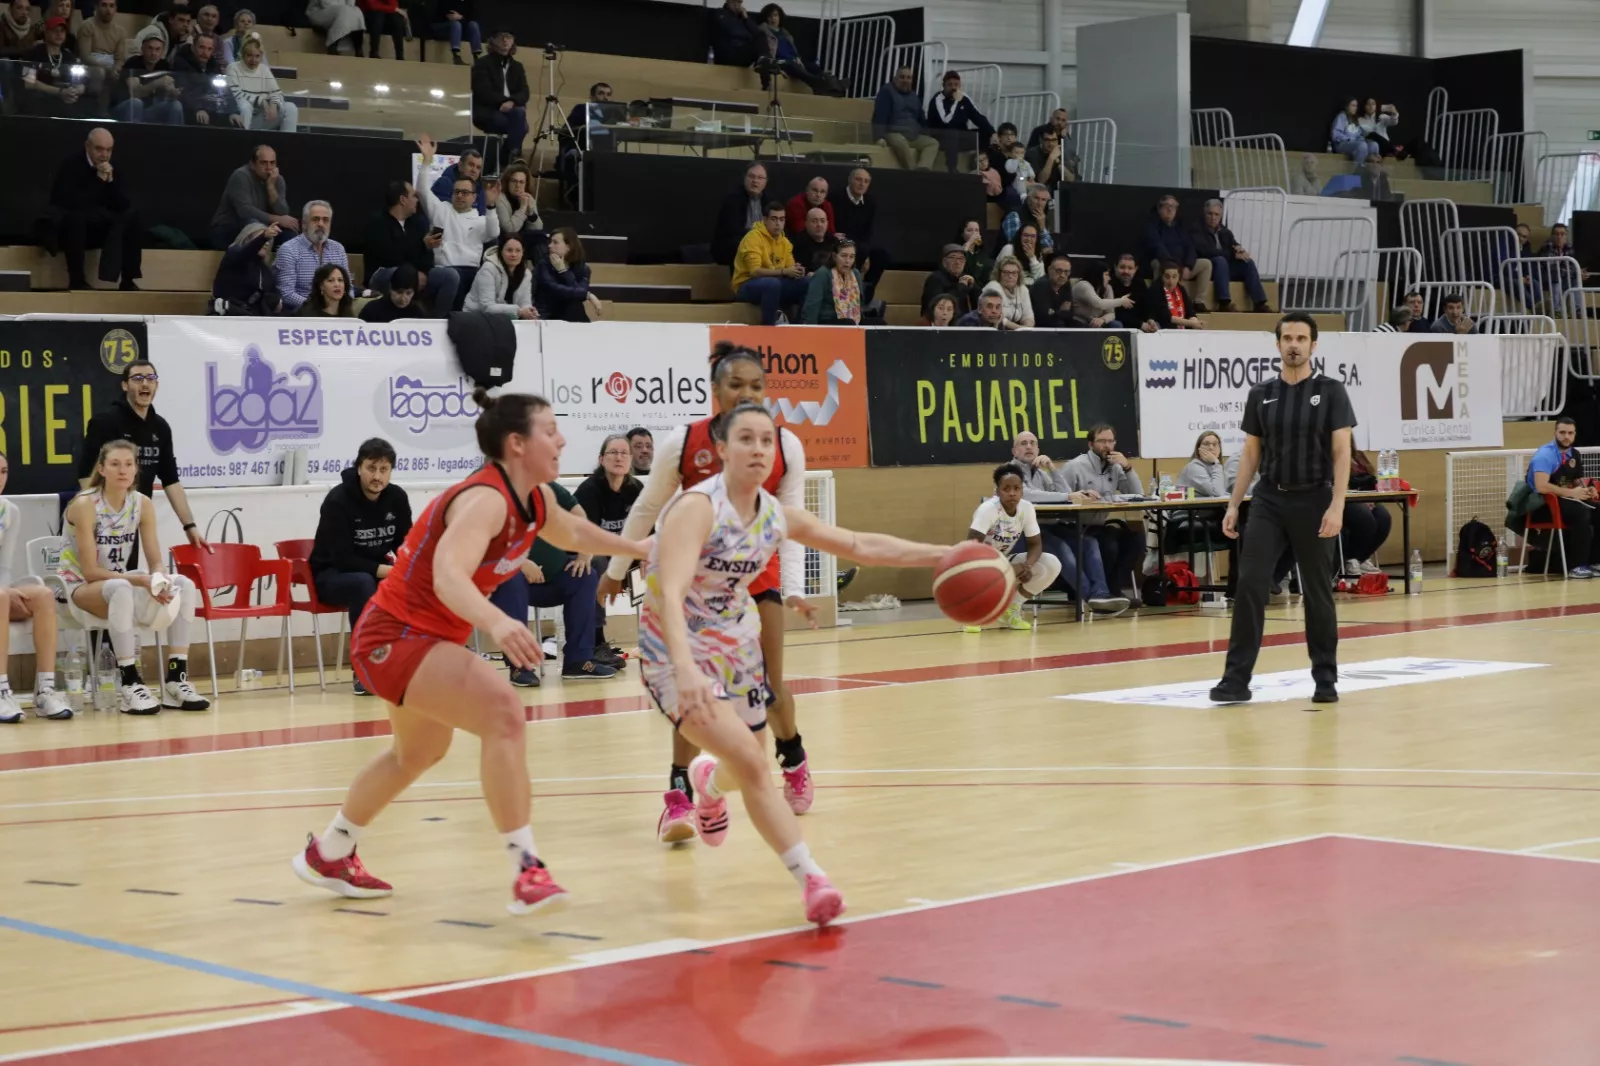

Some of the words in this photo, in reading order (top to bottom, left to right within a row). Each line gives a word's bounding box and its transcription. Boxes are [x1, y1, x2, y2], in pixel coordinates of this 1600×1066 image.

[278, 327, 433, 346] ESPECTÁCULOS
[104, 340, 135, 363] 75
[1104, 343, 1124, 362] 75
[949, 353, 1055, 368] EMBUTIDOS
[1457, 341, 1470, 418] MEDA
[551, 378, 583, 404] los
[916, 379, 1090, 444] PAJARIEL
[1439, 422, 1472, 434] Dental
[177, 463, 226, 477] ontactos:
[228, 462, 248, 476] 987
[251, 461, 270, 475] 467
[322, 459, 341, 473] 466
[411, 457, 429, 470] 865
[108, 547, 125, 563] 41
